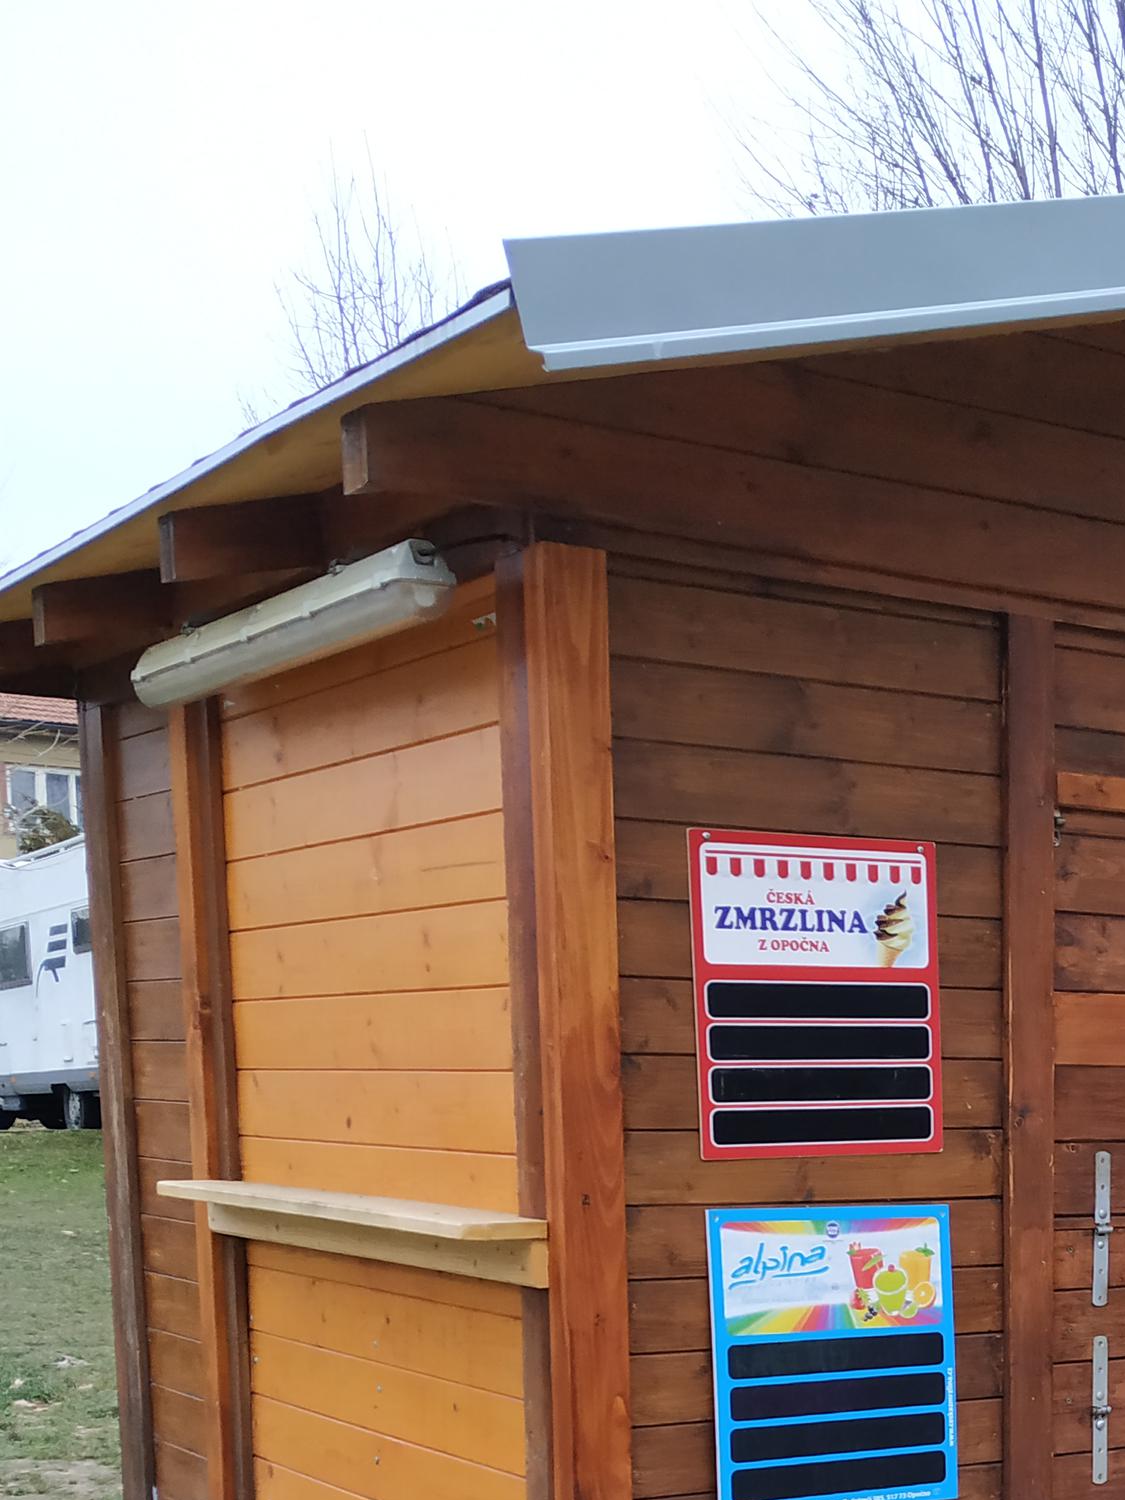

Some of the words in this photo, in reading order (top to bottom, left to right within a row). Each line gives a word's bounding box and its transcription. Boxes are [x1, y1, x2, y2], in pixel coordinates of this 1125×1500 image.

[766, 888, 815, 905] ČESKÁ
[714, 905, 868, 934] ZMRZLINA
[758, 939, 767, 951] Z
[771, 937, 830, 953] OPOČNA
[731, 1242, 826, 1281] alpina
